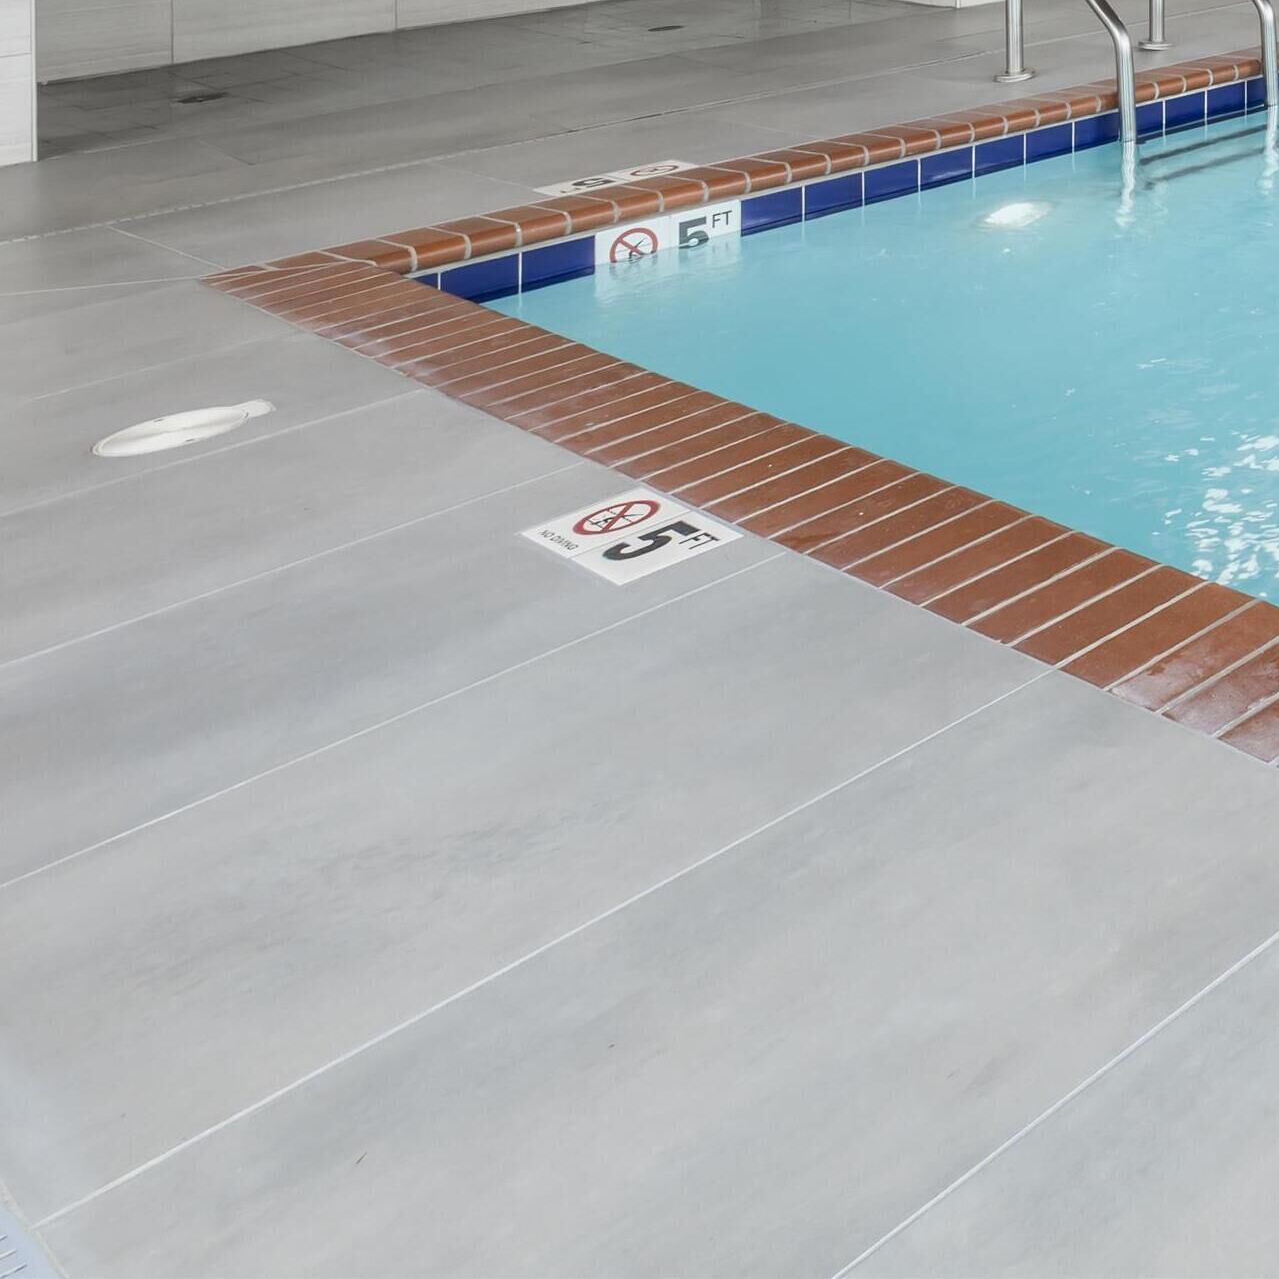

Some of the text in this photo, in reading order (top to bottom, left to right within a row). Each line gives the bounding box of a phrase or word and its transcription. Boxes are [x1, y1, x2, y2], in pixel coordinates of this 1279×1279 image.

[679, 210, 733, 250] 5 FT
[602, 520, 721, 561] 5 FT
